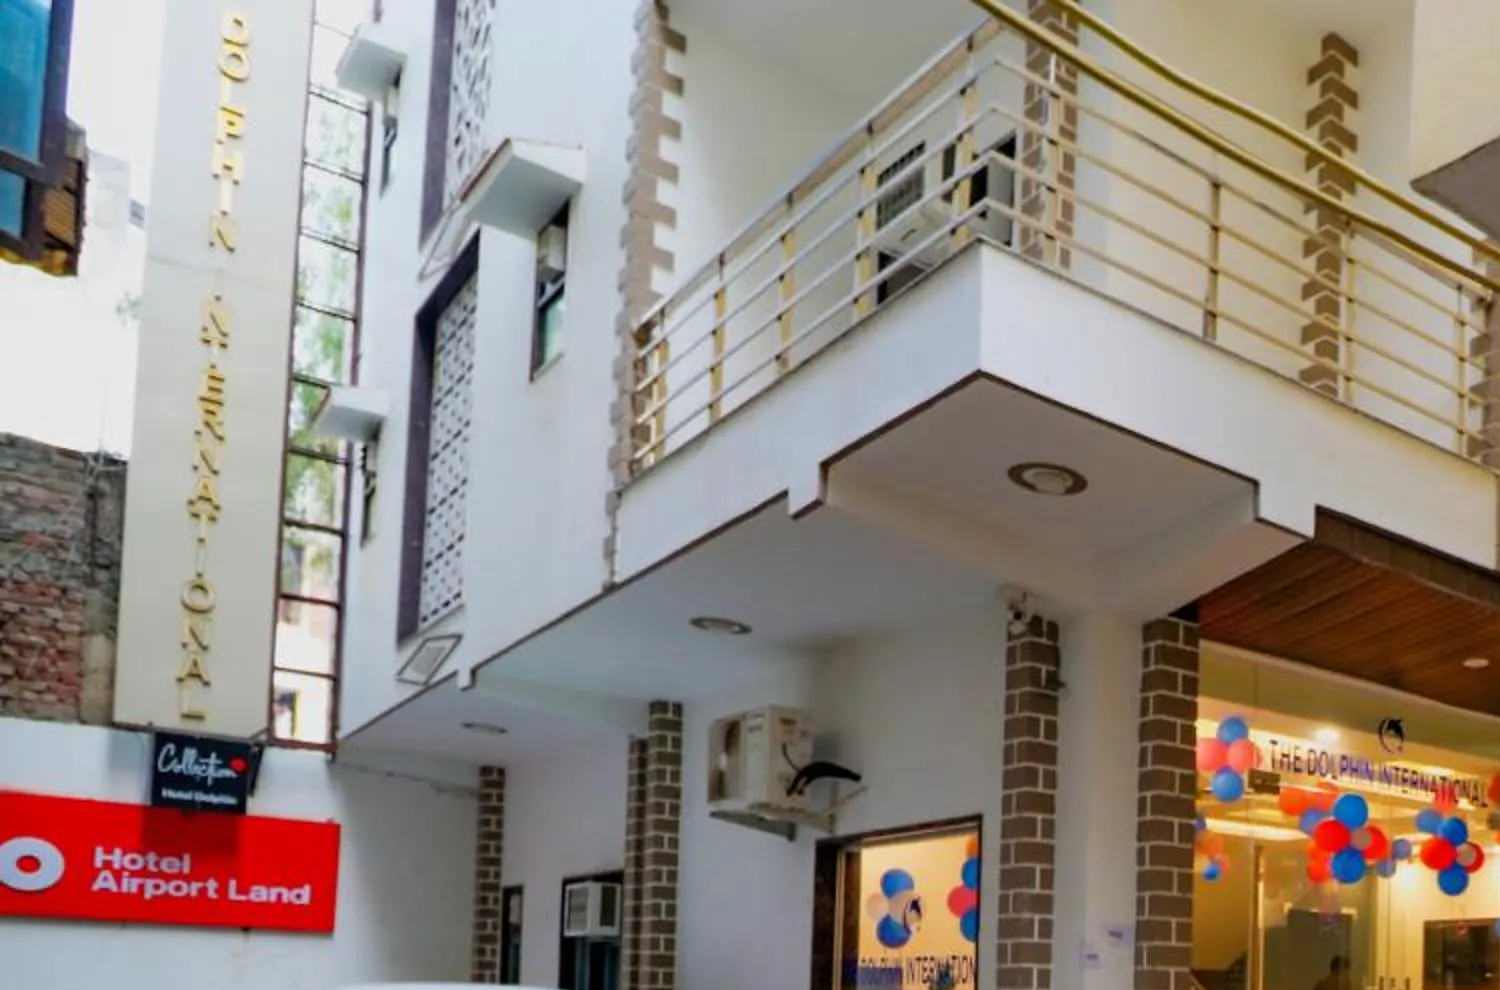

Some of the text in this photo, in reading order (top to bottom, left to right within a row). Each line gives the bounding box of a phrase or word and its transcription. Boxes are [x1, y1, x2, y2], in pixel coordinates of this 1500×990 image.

[1270, 739, 1489, 808] THE DOLPHIN INTERNATIONAL
[93, 846, 191, 874] Hotel
[91, 870, 311, 905] Airport Land
